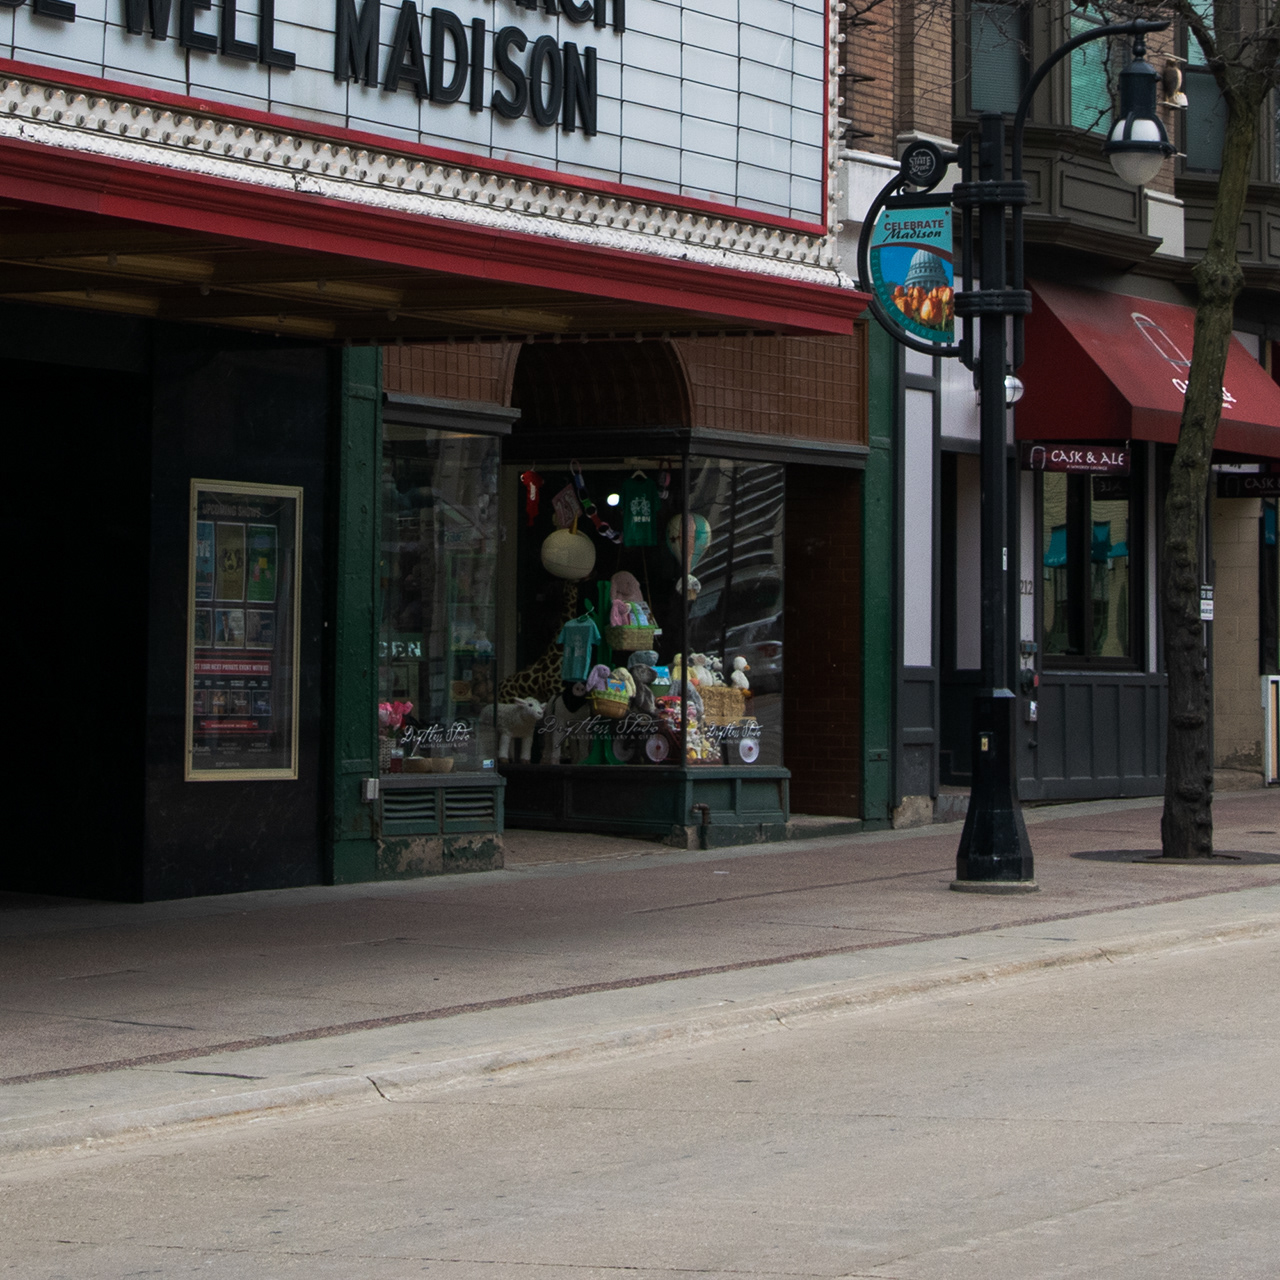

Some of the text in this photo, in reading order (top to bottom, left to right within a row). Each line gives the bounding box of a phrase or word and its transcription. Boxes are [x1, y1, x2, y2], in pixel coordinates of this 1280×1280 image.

[909, 156, 932, 167] STATE
[884, 219, 945, 232] CELEBRATE
[883, 227, 942, 242] Madison
[1051, 450, 1124, 465] CASK & ALE
[1244, 478, 1275, 489] CASK
[202, 504, 237, 516] UPCOMING
[1020, 580, 1032, 595] 212
[616, 713, 664, 734] Studio
[446, 722, 473, 742] Studio
